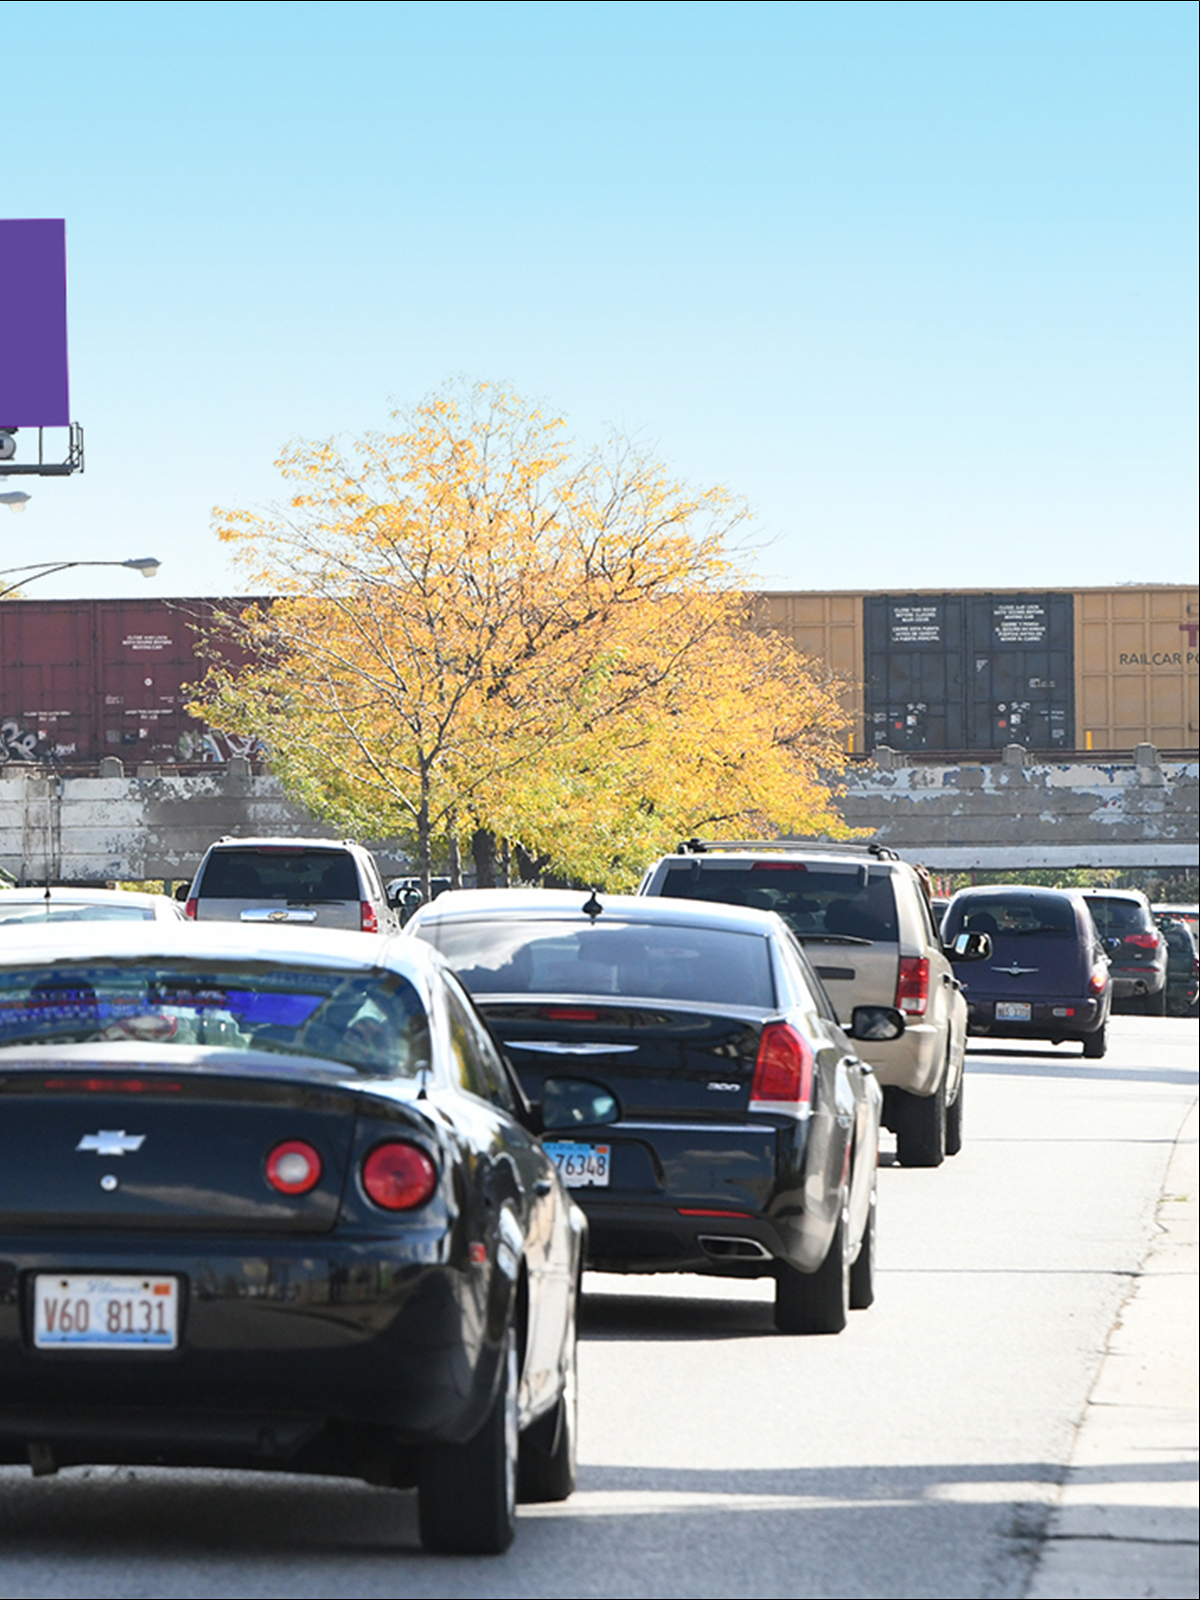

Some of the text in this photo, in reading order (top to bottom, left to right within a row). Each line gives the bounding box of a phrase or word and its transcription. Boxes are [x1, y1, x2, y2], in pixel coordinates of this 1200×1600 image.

[1119, 652, 1183, 666] RAILCAR
[555, 1153, 607, 1177] 76348
[43, 1297, 169, 1335] V60 8131
